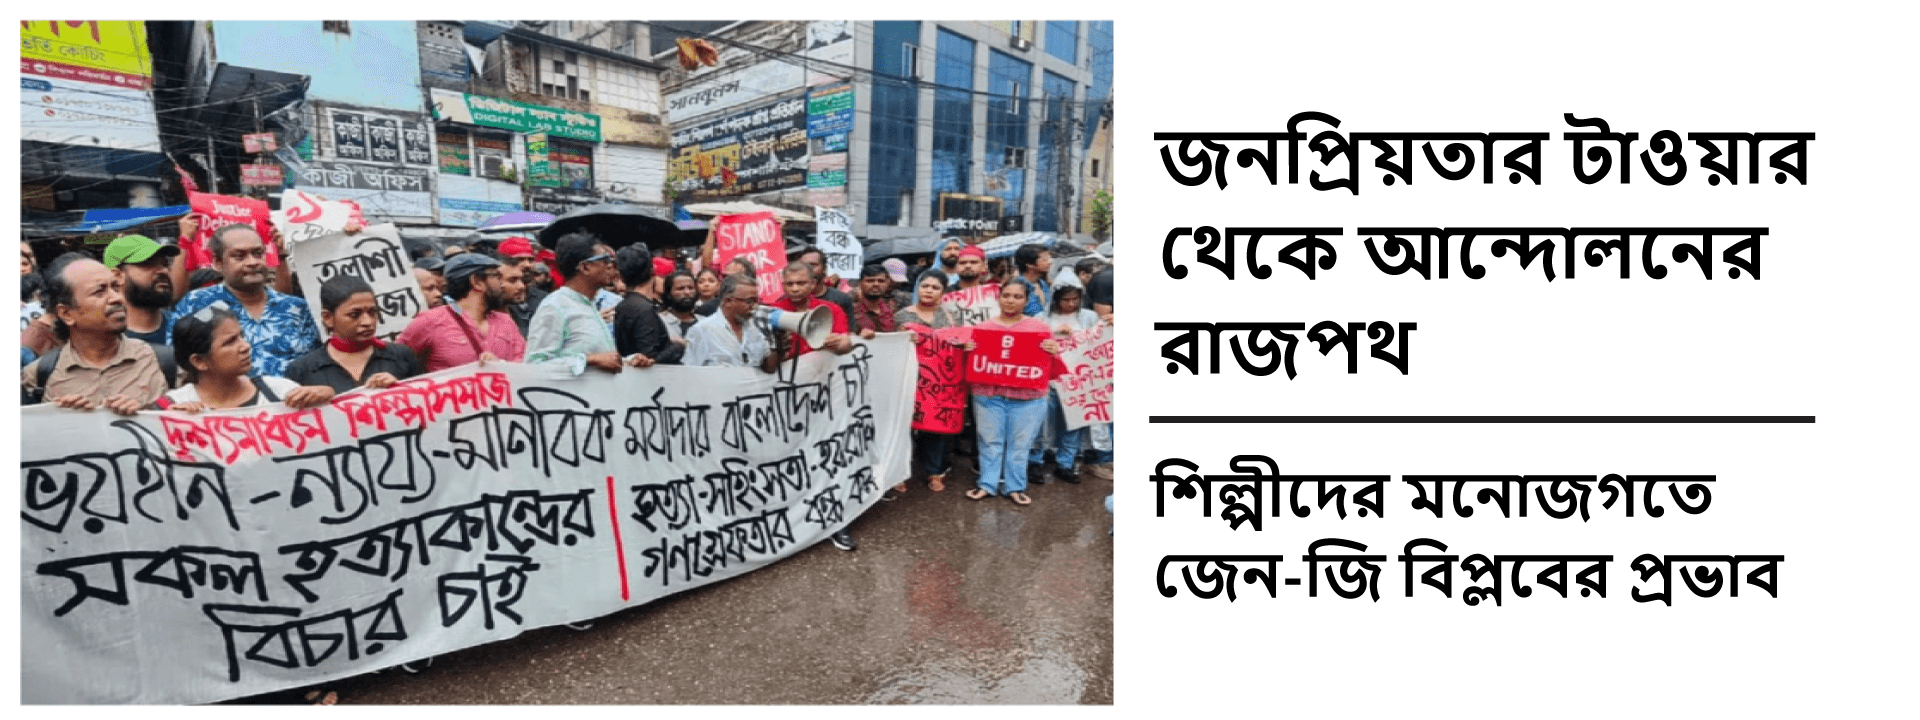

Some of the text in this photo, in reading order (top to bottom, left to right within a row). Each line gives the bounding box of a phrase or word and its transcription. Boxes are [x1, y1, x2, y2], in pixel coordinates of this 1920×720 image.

[473, 111, 597, 138] DIGITAL LAB STUDIO
[302, 163, 356, 188] কাজী
[361, 168, 424, 191] অফিস
[201, 215, 257, 232] Delad
[720, 219, 776, 251] STAND
[735, 249, 775, 270] OR
[1001, 349, 1011, 359] E
[1002, 335, 1014, 348] B
[624, 386, 711, 461] মর্যাদার
[37, 546, 268, 616] সকল
[202, 553, 540, 682] বিচার চাই
